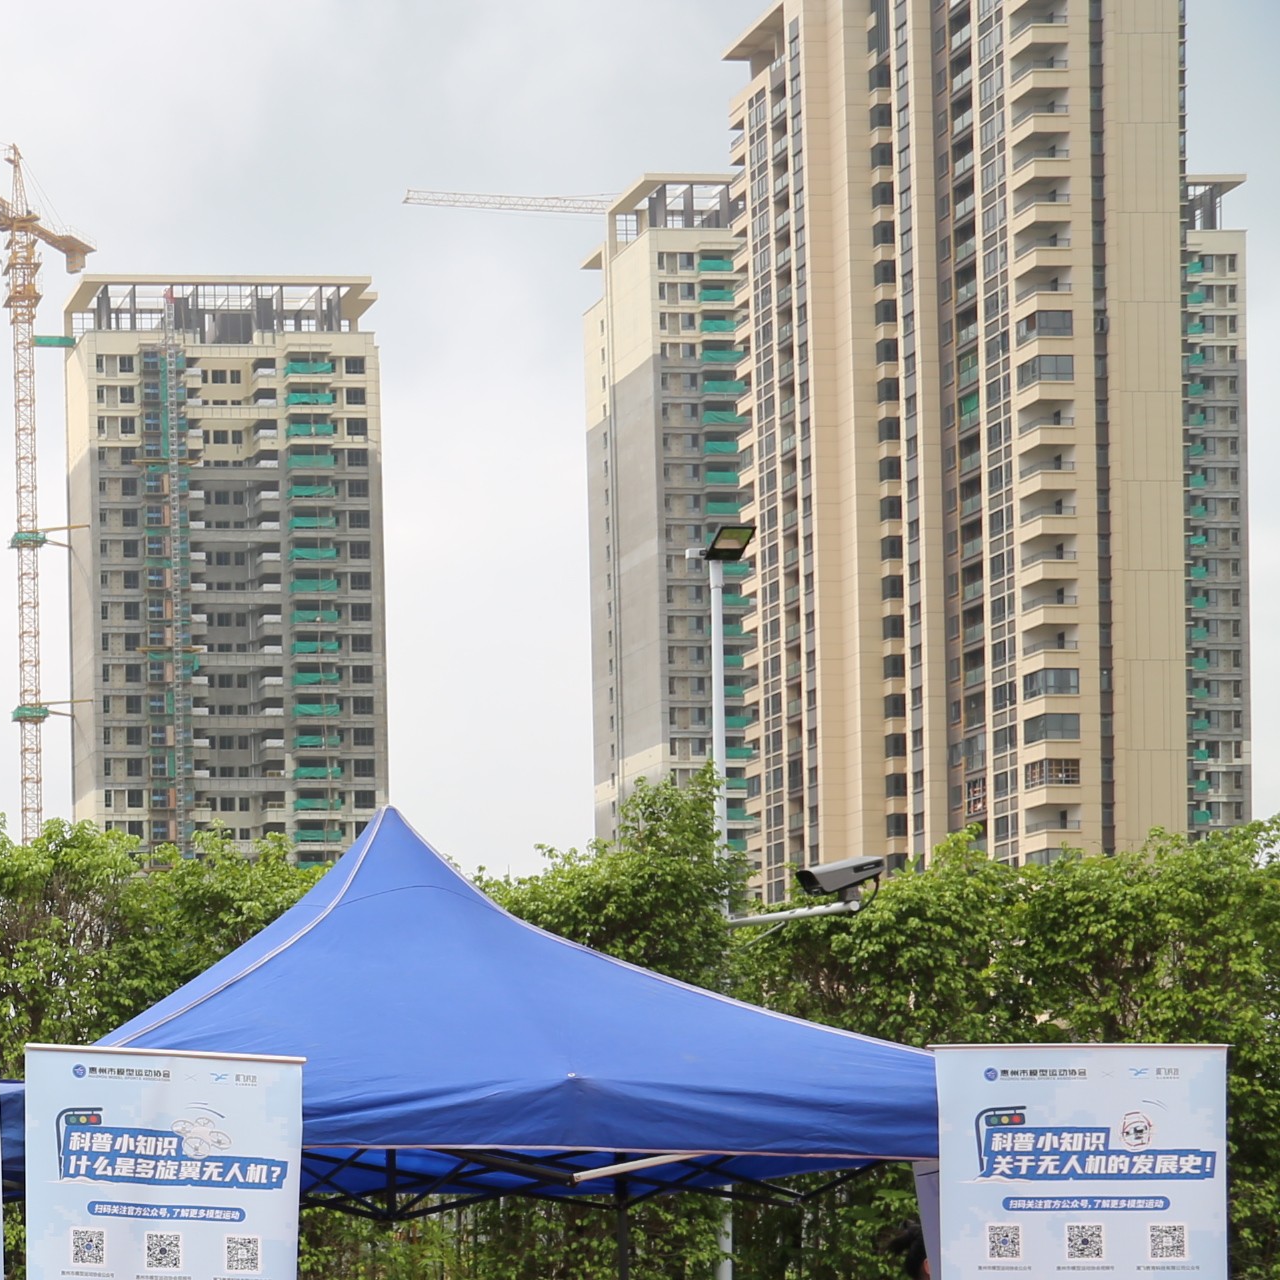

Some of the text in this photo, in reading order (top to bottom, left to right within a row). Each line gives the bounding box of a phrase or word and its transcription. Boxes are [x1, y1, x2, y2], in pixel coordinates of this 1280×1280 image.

[89, 1067, 170, 1078] 惠州市模型运动协会
[1000, 1068, 1087, 1077] 惠州市模型运动协会
